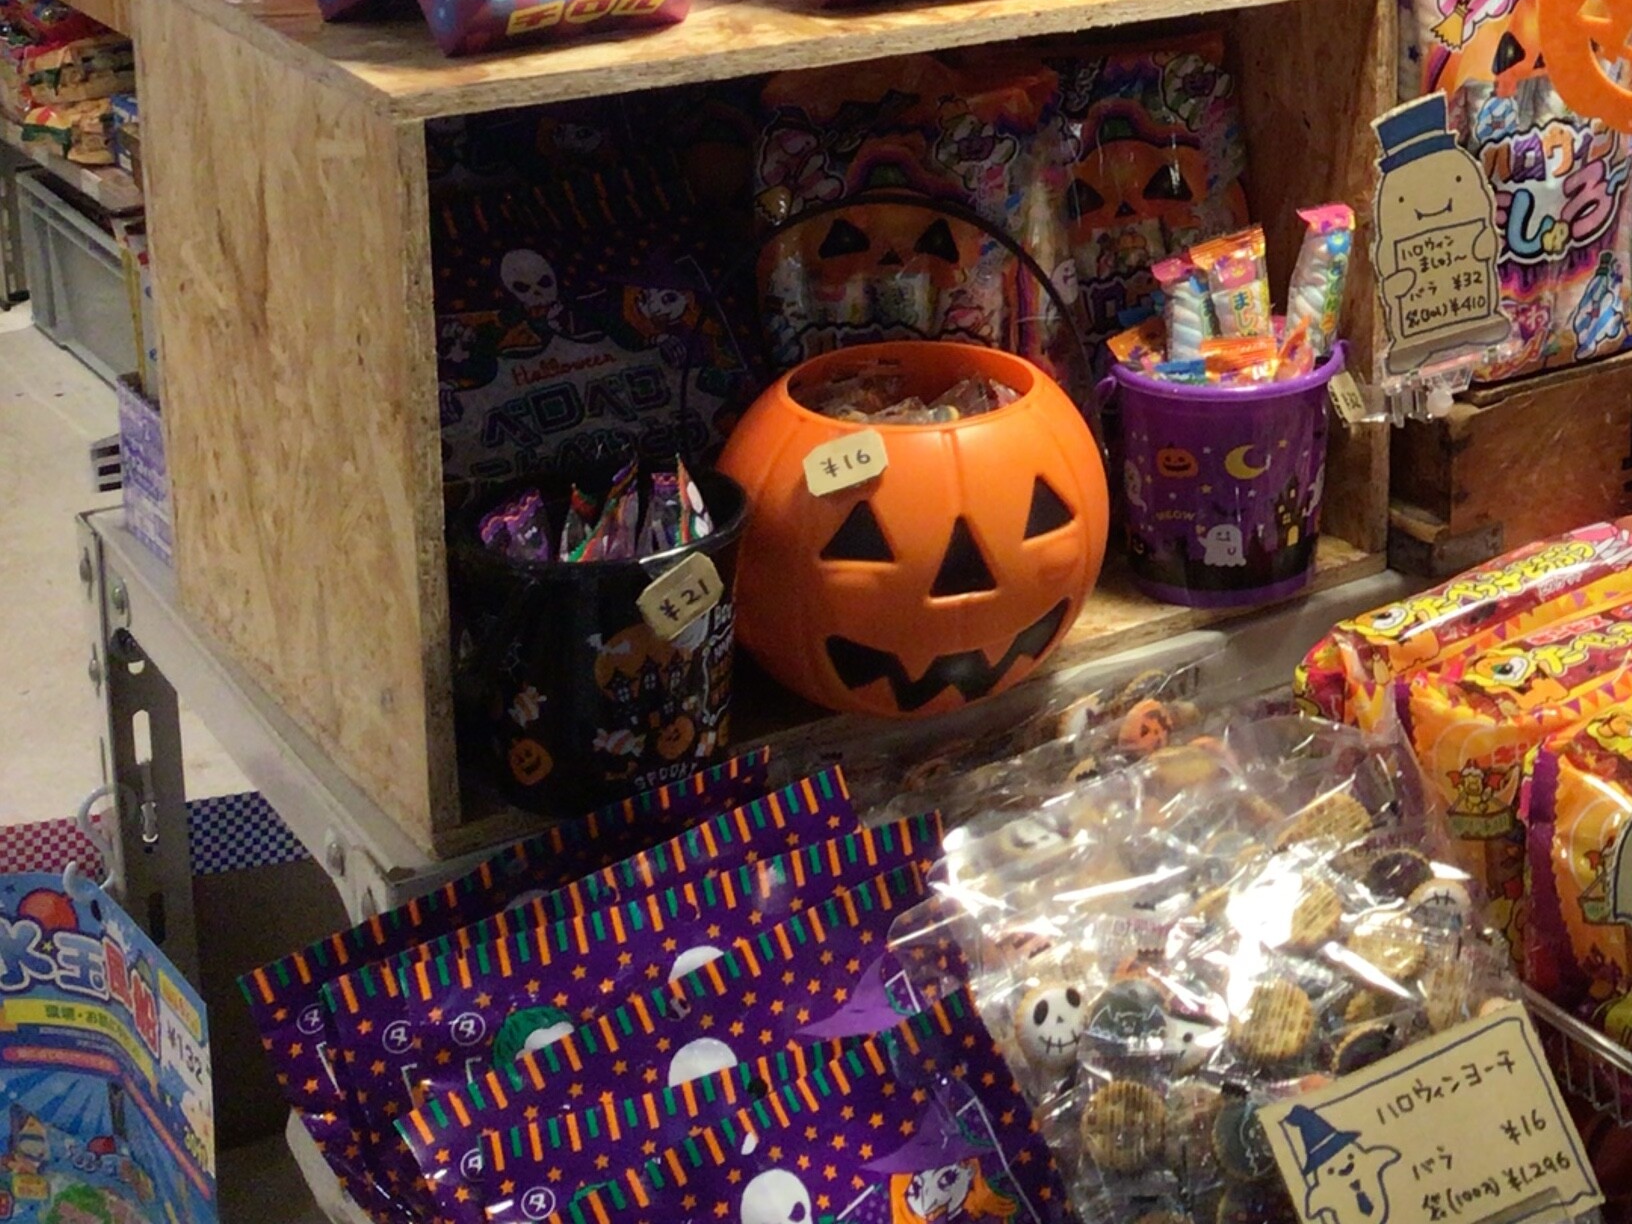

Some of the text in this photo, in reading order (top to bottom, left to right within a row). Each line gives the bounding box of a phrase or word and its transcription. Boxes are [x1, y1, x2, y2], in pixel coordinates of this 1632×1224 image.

[1401, 236, 1454, 261] ハロウィン
[1410, 271, 1483, 301] バラ ¥32
[1449, 296, 1486, 316] ¥410
[819, 448, 872, 478] ¥16
[659, 578, 710, 622] ¥21
[1375, 1050, 1516, 1126] ハロウィンヨーチ
[1499, 1108, 1547, 1146] ¥16
[1410, 1145, 1454, 1180] バラ
